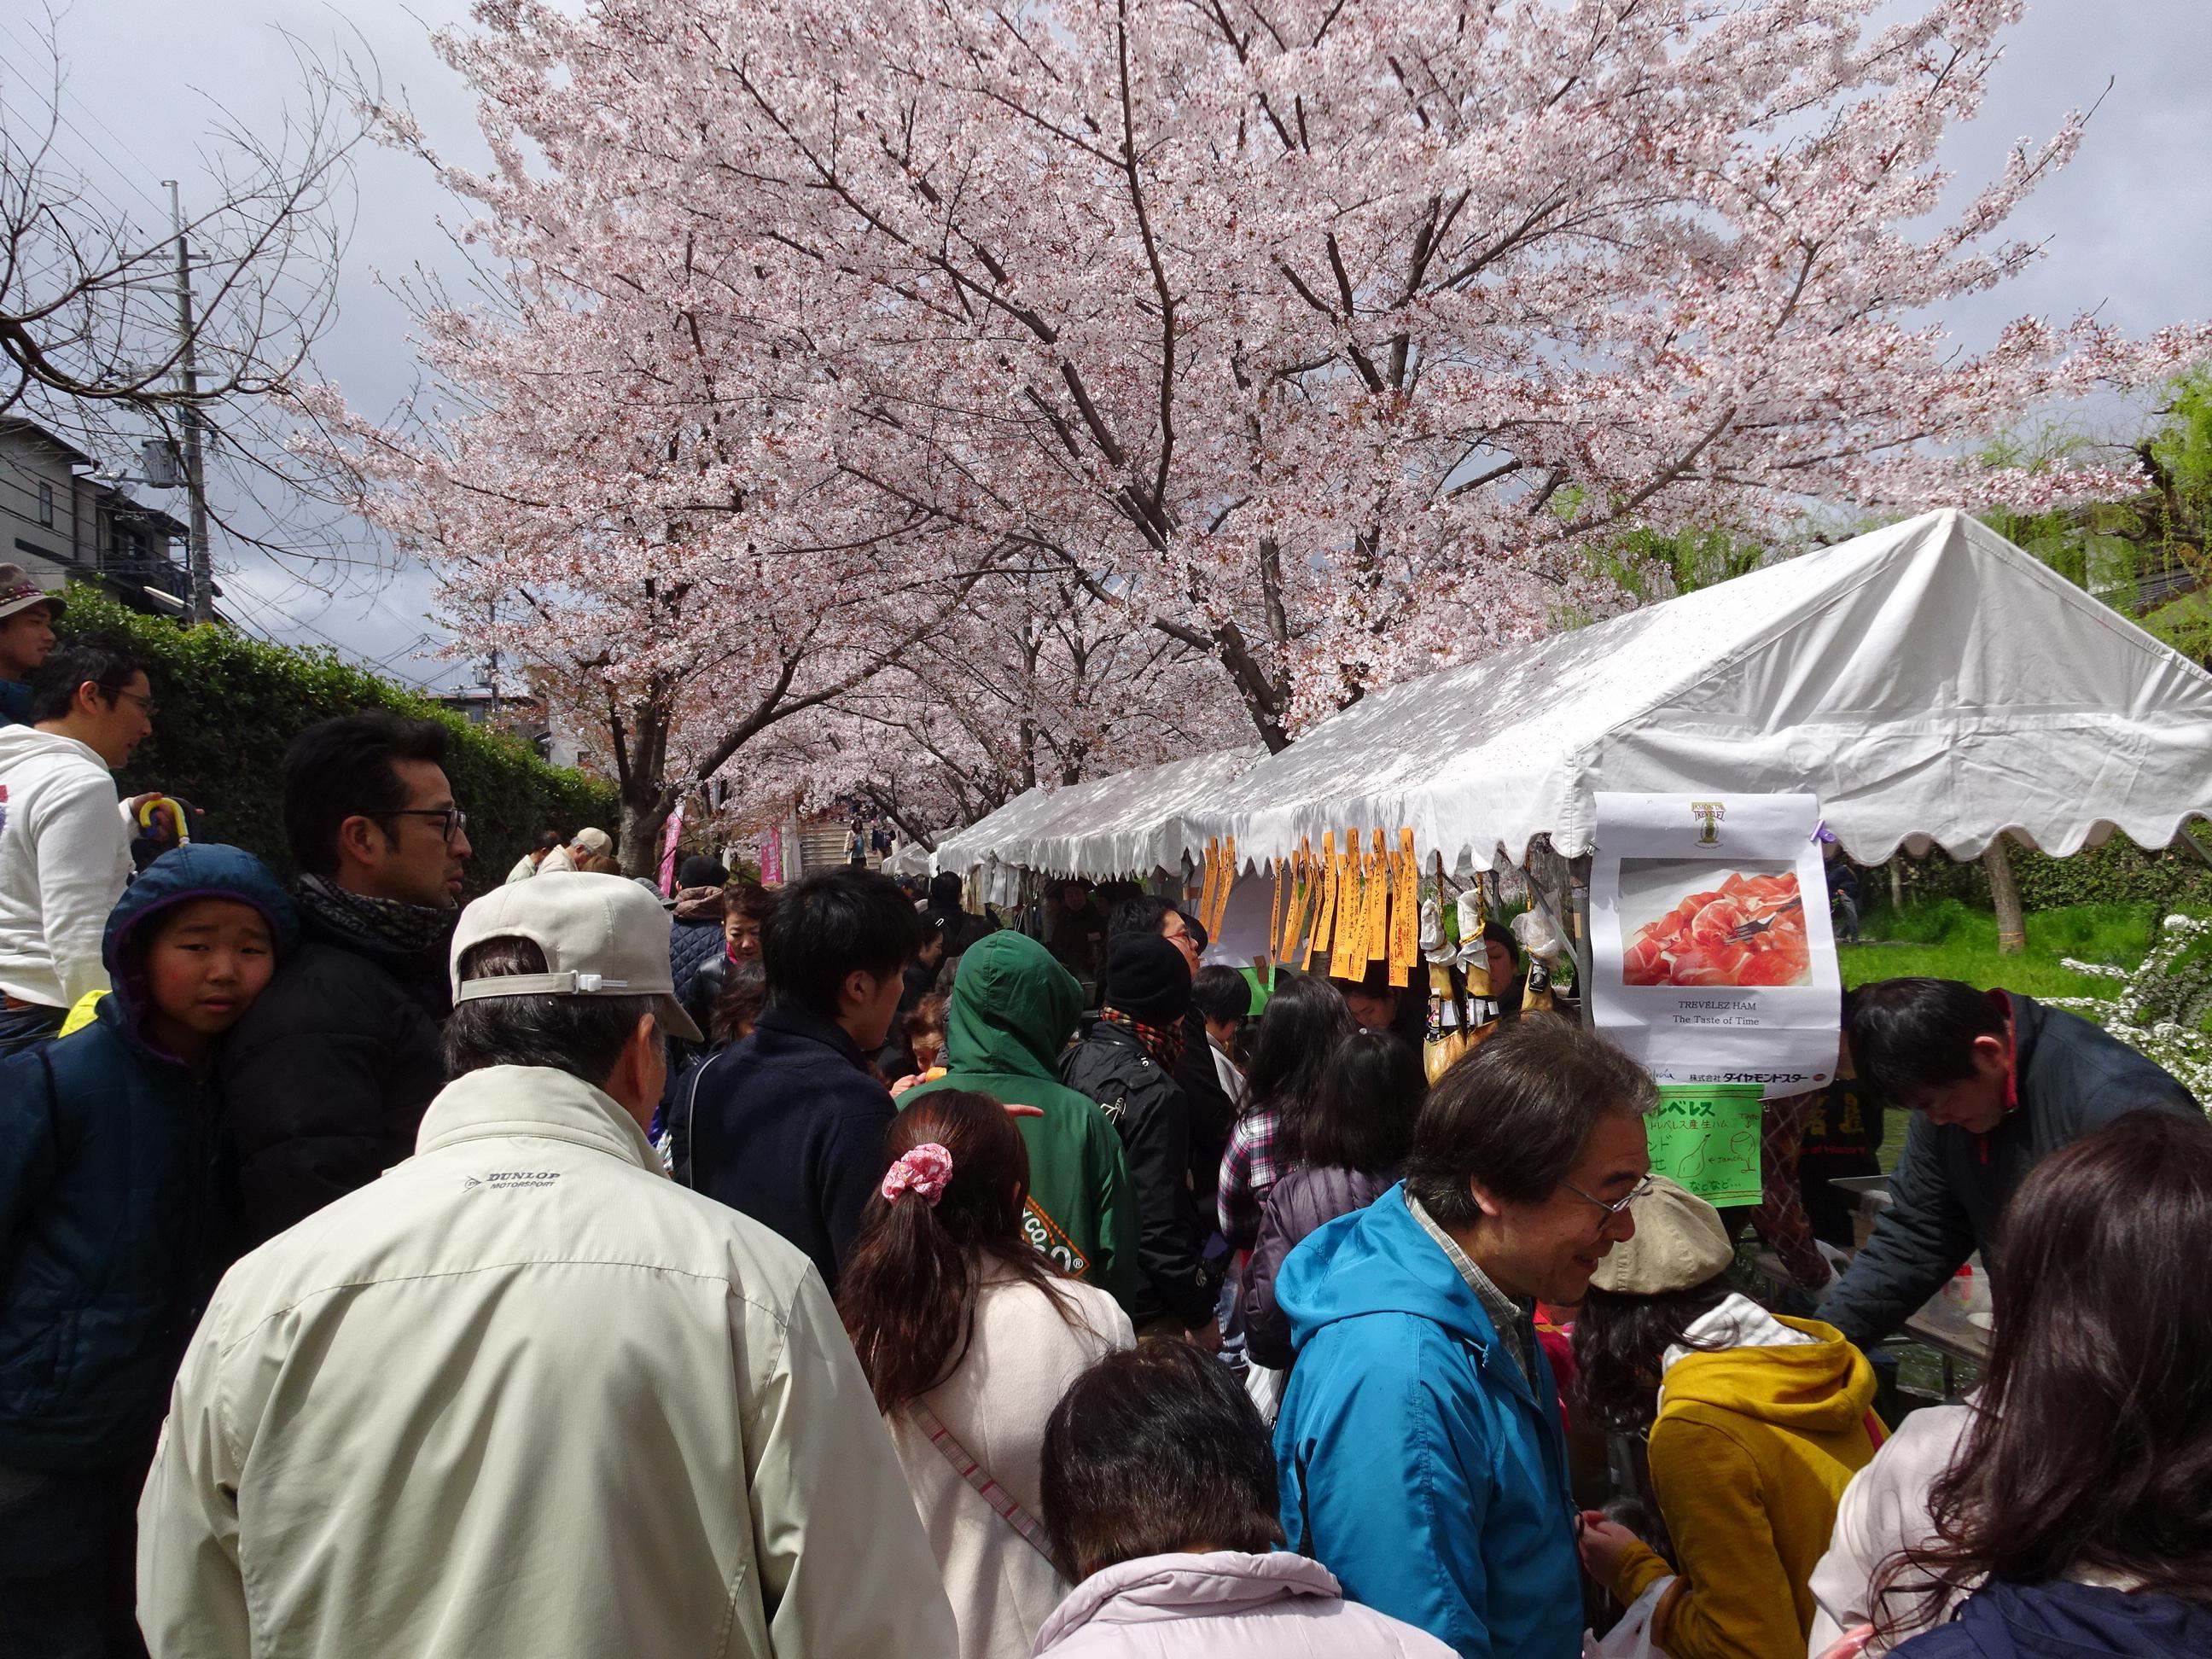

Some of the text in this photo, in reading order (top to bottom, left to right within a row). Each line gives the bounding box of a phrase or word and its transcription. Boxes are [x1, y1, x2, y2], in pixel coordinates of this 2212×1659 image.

[1732, 1002, 1756, 1010] HAM
[1673, 1014, 1760, 1026] The Taste of Time
[1690, 1073, 1808, 1083] 株式会社 ダイヤモンドスター
[486, 1172, 561, 1182] DUNLOP
